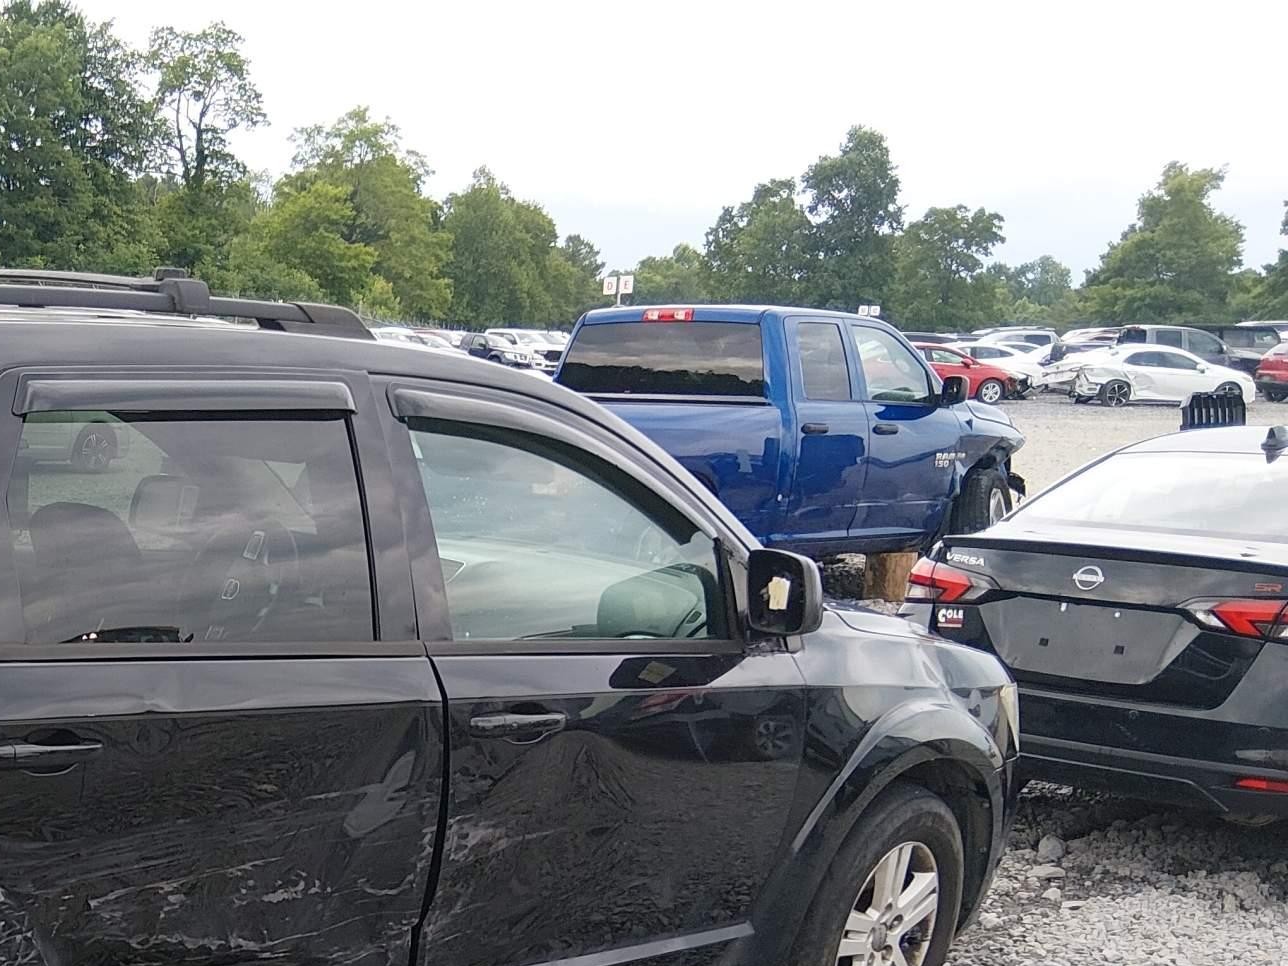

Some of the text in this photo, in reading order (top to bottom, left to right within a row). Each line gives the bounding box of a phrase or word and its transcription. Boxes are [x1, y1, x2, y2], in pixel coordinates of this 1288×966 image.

[946, 552, 985, 567] VERSA
[1255, 582, 1283, 593] SR
[937, 608, 964, 622] COLE
